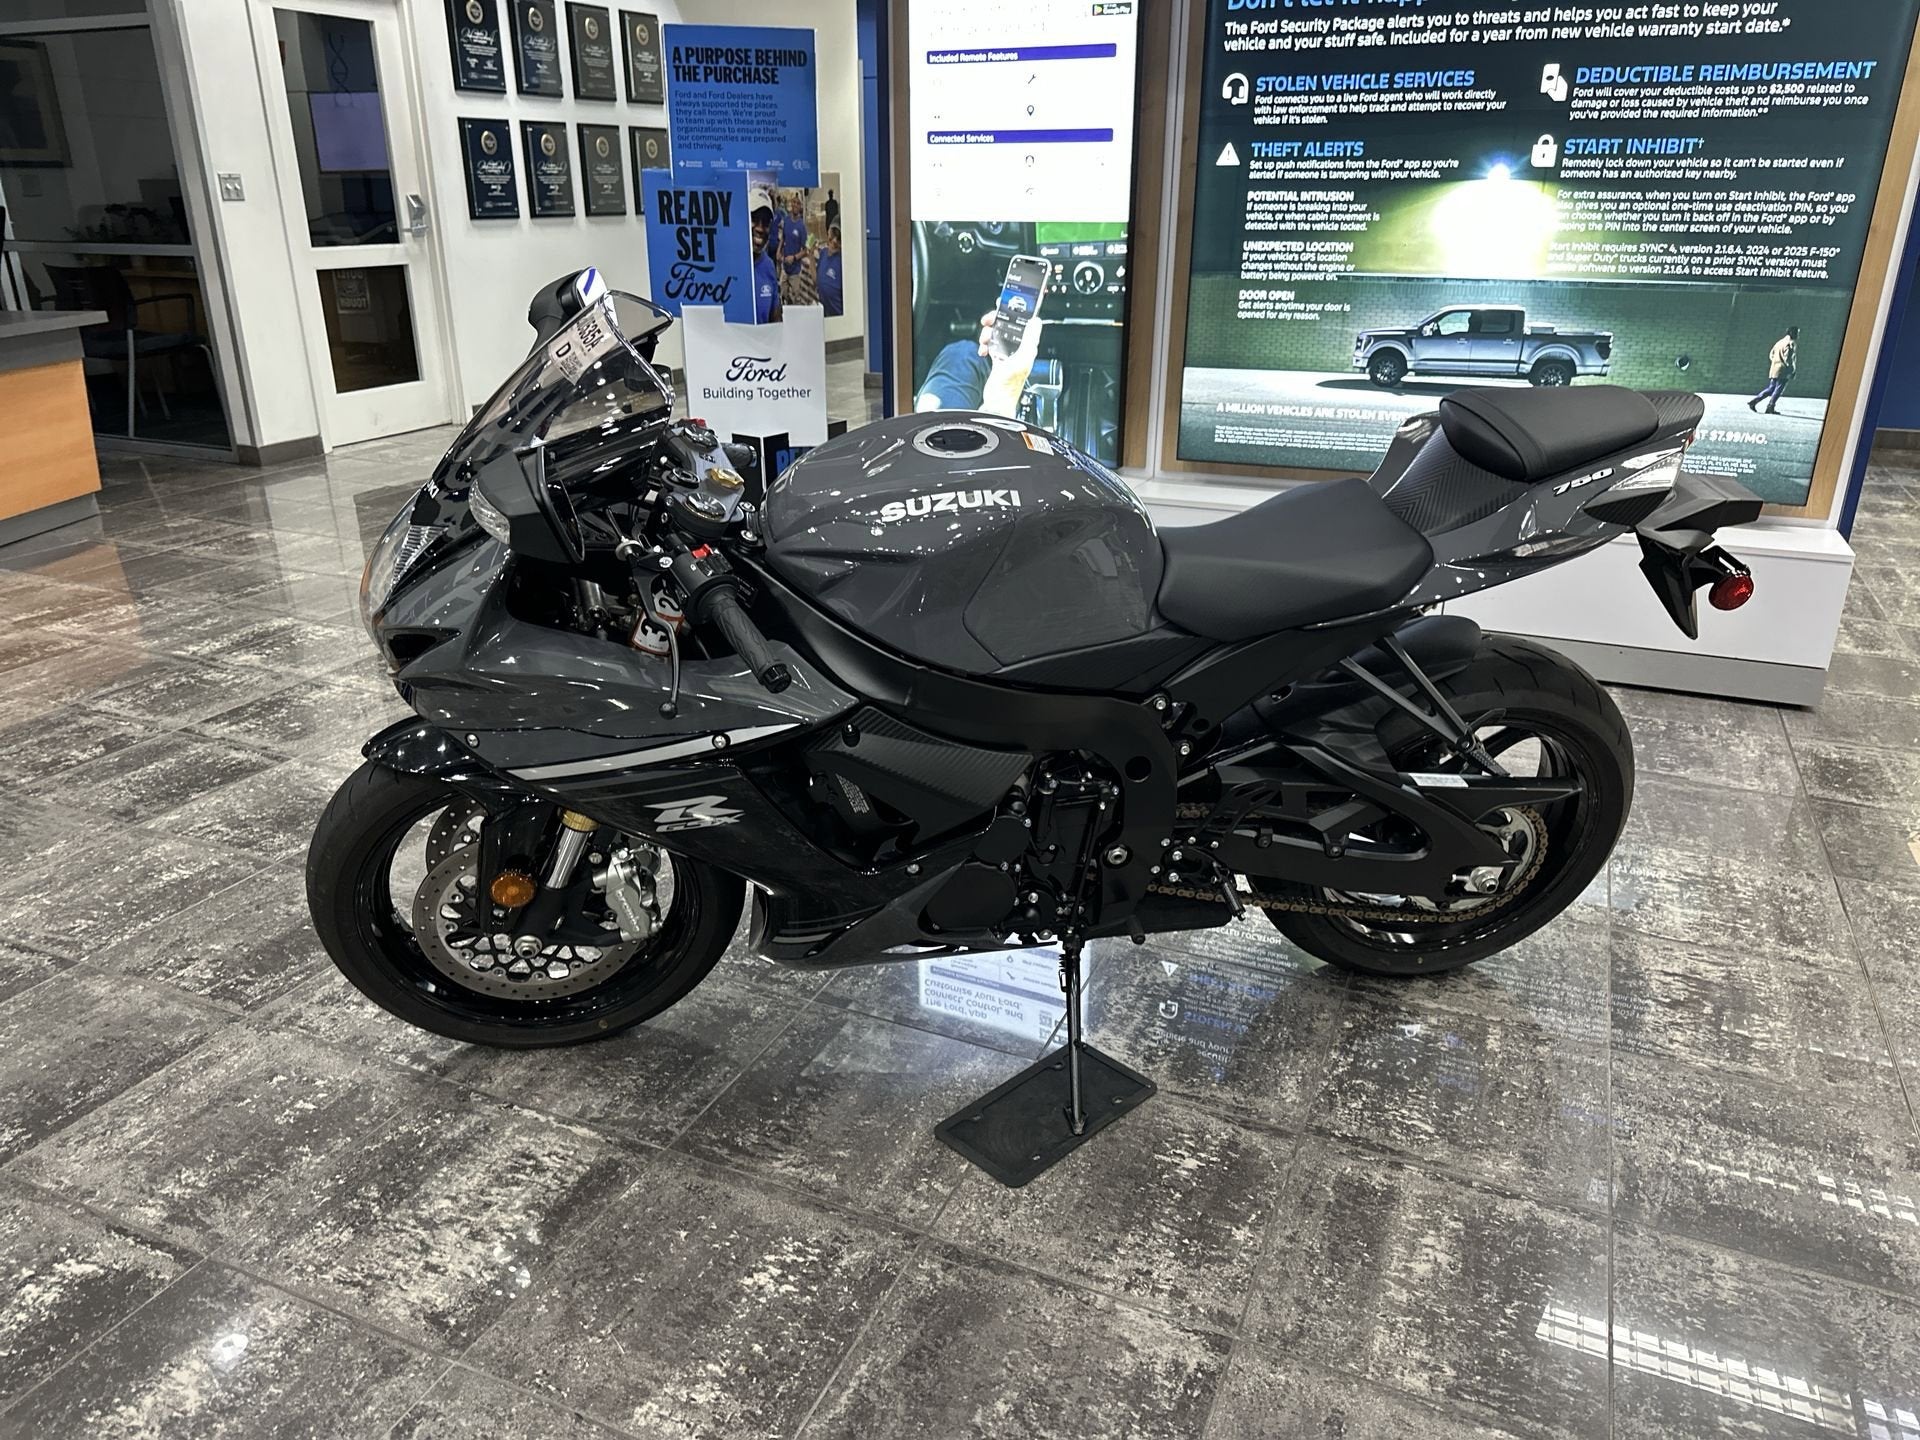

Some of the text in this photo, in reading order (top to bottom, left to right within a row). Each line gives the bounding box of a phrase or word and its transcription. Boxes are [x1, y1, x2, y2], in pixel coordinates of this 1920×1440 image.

[1225, 3, 1777, 35] The Ford Security Package alerts you to threats and helps you act fast to keep your
[1224, 37, 1265, 51] vehicle
[1268, 36, 1291, 49] and
[1294, 38, 1322, 52] your
[1325, 34, 1355, 48] stuff
[1357, 33, 1386, 46] safe.
[1390, 31, 1446, 45] Included
[1450, 30, 1468, 43] for
[1472, 32, 1479, 42] a
[1483, 31, 1512, 45] year
[1515, 27, 1547, 40] from
[1552, 29, 1581, 39] new
[1585, 24, 1634, 38] vehicle
[1638, 22, 1702, 40] warranty
[1706, 21, 1741, 35] start
[672, 47, 807, 67] A PURPOSE BEHIND
[929, 51, 1018, 63] Included Remote Features
[674, 66, 699, 83] THE
[704, 66, 779, 85] PURCHASE
[1576, 62, 1876, 84] DEDUCTIBLE REIMBURSEMENT
[1256, 71, 1474, 92] STOLEN VEHICLE SERVICES
[675, 91, 691, 99] Ford
[693, 91, 706, 99] and
[726, 92, 754, 100] Dealers
[755, 92, 773, 100] have
[1255, 95, 1272, 104] Ford
[1274, 94, 1308, 104] connects
[1310, 96, 1324, 105] you
[1326, 93, 1334, 102] to
[1343, 93, 1357, 102] live
[1359, 92, 1378, 102] Ford
[1379, 92, 1402, 103] agent
[1405, 91, 1422, 101] who
[1425, 91, 1440, 100] will
[1442, 90, 1462, 100] work
[1464, 90, 1496, 101] directly
[1573, 87, 1593, 96] Ford
[1596, 87, 1611, 96] will
[1640, 89, 1660, 98] your
[1663, 86, 1712, 96] deductible
[1714, 85, 1738, 95] costs
[1742, 88, 1754, 97] up
[1757, 85, 1767, 94] to
[1770, 85, 1804, 96] $2,500
[1806, 84, 1841, 94] related
[1844, 84, 1855, 93] to
[675, 100, 699, 109] always
[702, 100, 739, 110] supported
[754, 101, 778, 110] places
[676, 108, 691, 117] they
[693, 108, 706, 116] call
[754, 109, 775, 118] proud
[676, 116, 683, 124] to
[685, 116, 704, 124] team
[717, 117, 732, 125] with
[734, 117, 754, 125] these
[756, 118, 786, 127] amazing
[677, 125, 726, 135] organizations
[763, 126, 777, 134] that
[691, 133, 738, 142] communities
[753, 135, 786, 144] prepared
[930, 133, 994, 143] Connected Services
[1252, 141, 1364, 158] THEFT ALERTS
[1564, 139, 1622, 154] START
[1562, 158, 1603, 170] Remotely
[1605, 158, 1623, 167] lock
[1626, 158, 1651, 167] down
[1653, 161, 1674, 170] your
[1676, 158, 1708, 168] vehicle
[1724, 158, 1730, 168] it
[1758, 158, 1770, 168] be
[1773, 158, 1807, 168] started
[1836, 158, 1844, 168] if
[1247, 191, 1354, 201] POTENTIAL INTRUSION
[657, 189, 733, 227] READY
[676, 226, 717, 263] SET
[1244, 242, 1354, 252] UNEXPECTED LOCATION
[1239, 290, 1294, 301] DOOR OPEN
[725, 356, 787, 382] Ford
[703, 387, 811, 400] Building Together
[1216, 403, 1223, 413] A
[1226, 404, 1264, 415] MILLION
[1267, 405, 1312, 417] VEHICLES
[1314, 407, 1334, 418] ARE
[1709, 431, 1768, 444] $7.99/MO.
[1553, 467, 1615, 496] 750
[881, 489, 1021, 523] SUZUKI
